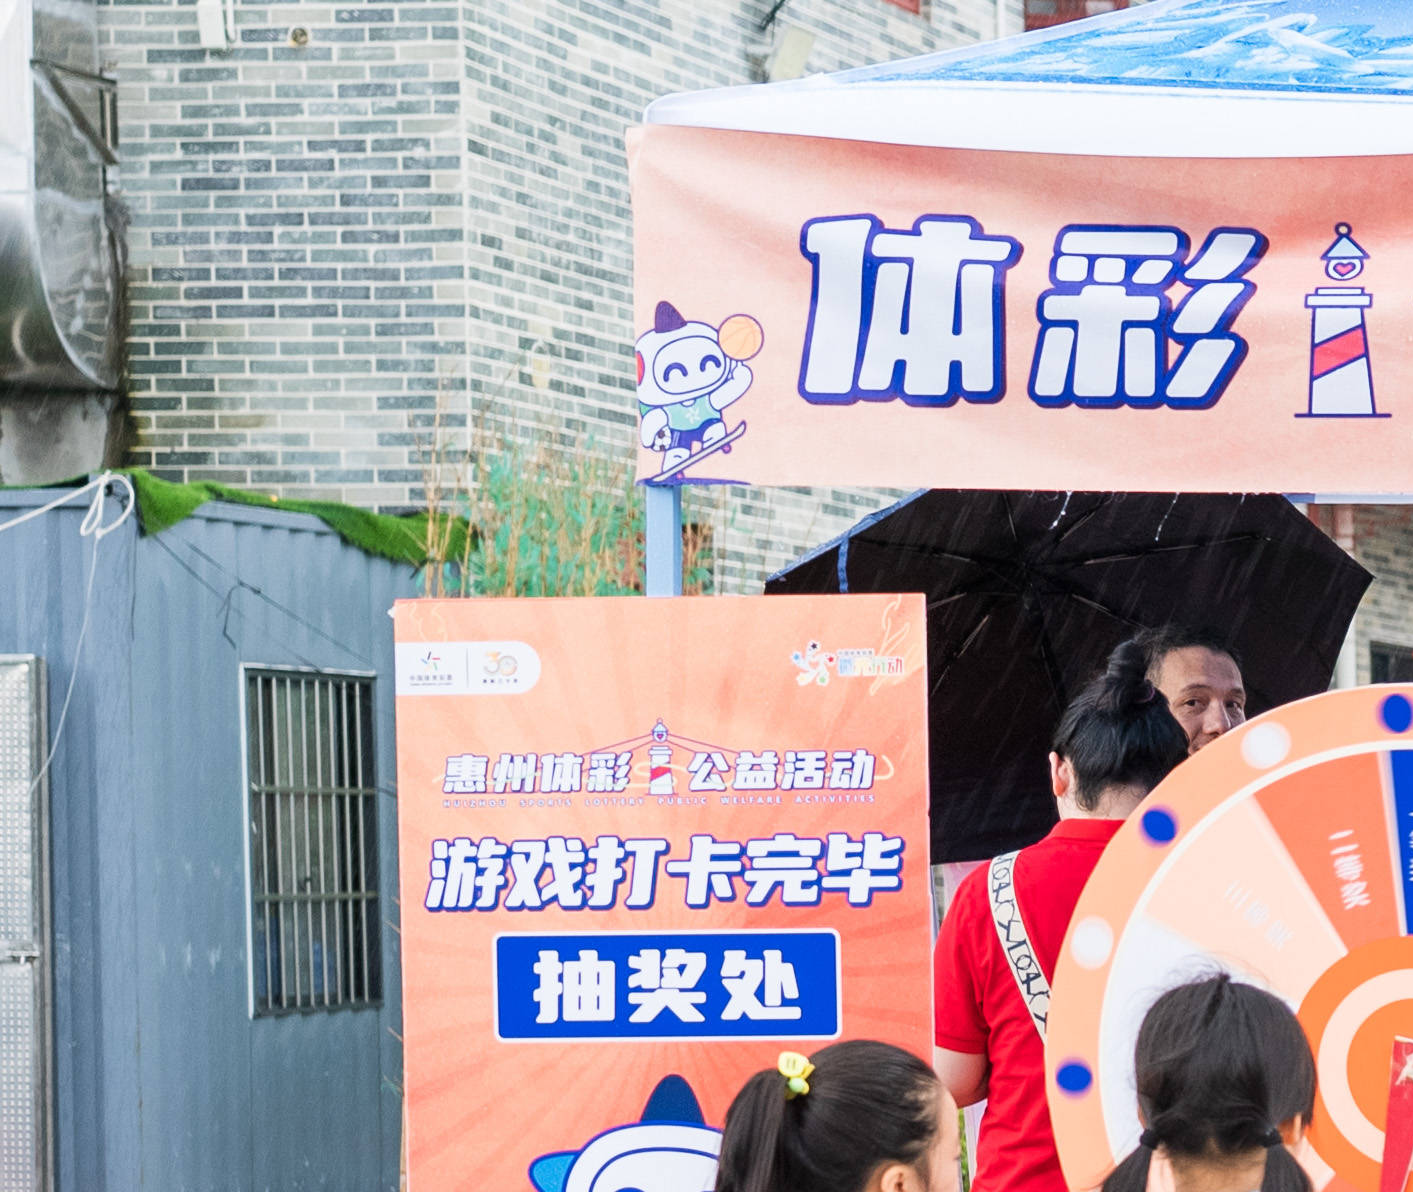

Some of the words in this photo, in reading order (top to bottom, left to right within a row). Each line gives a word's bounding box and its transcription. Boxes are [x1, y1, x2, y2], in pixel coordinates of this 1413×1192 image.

[799, 213, 1269, 411] 体彩
[442, 751, 633, 794] 惠州体彩
[688, 748, 878, 791] 公益活动
[519, 798, 573, 807] SPORTS
[585, 797, 645, 806] LOTTERY
[657, 796, 708, 805] PUBLIC
[720, 795, 783, 805] WELFARE
[425, 831, 905, 912] 游戏打卡完毕
[532, 948, 802, 1024] 抽奖处
